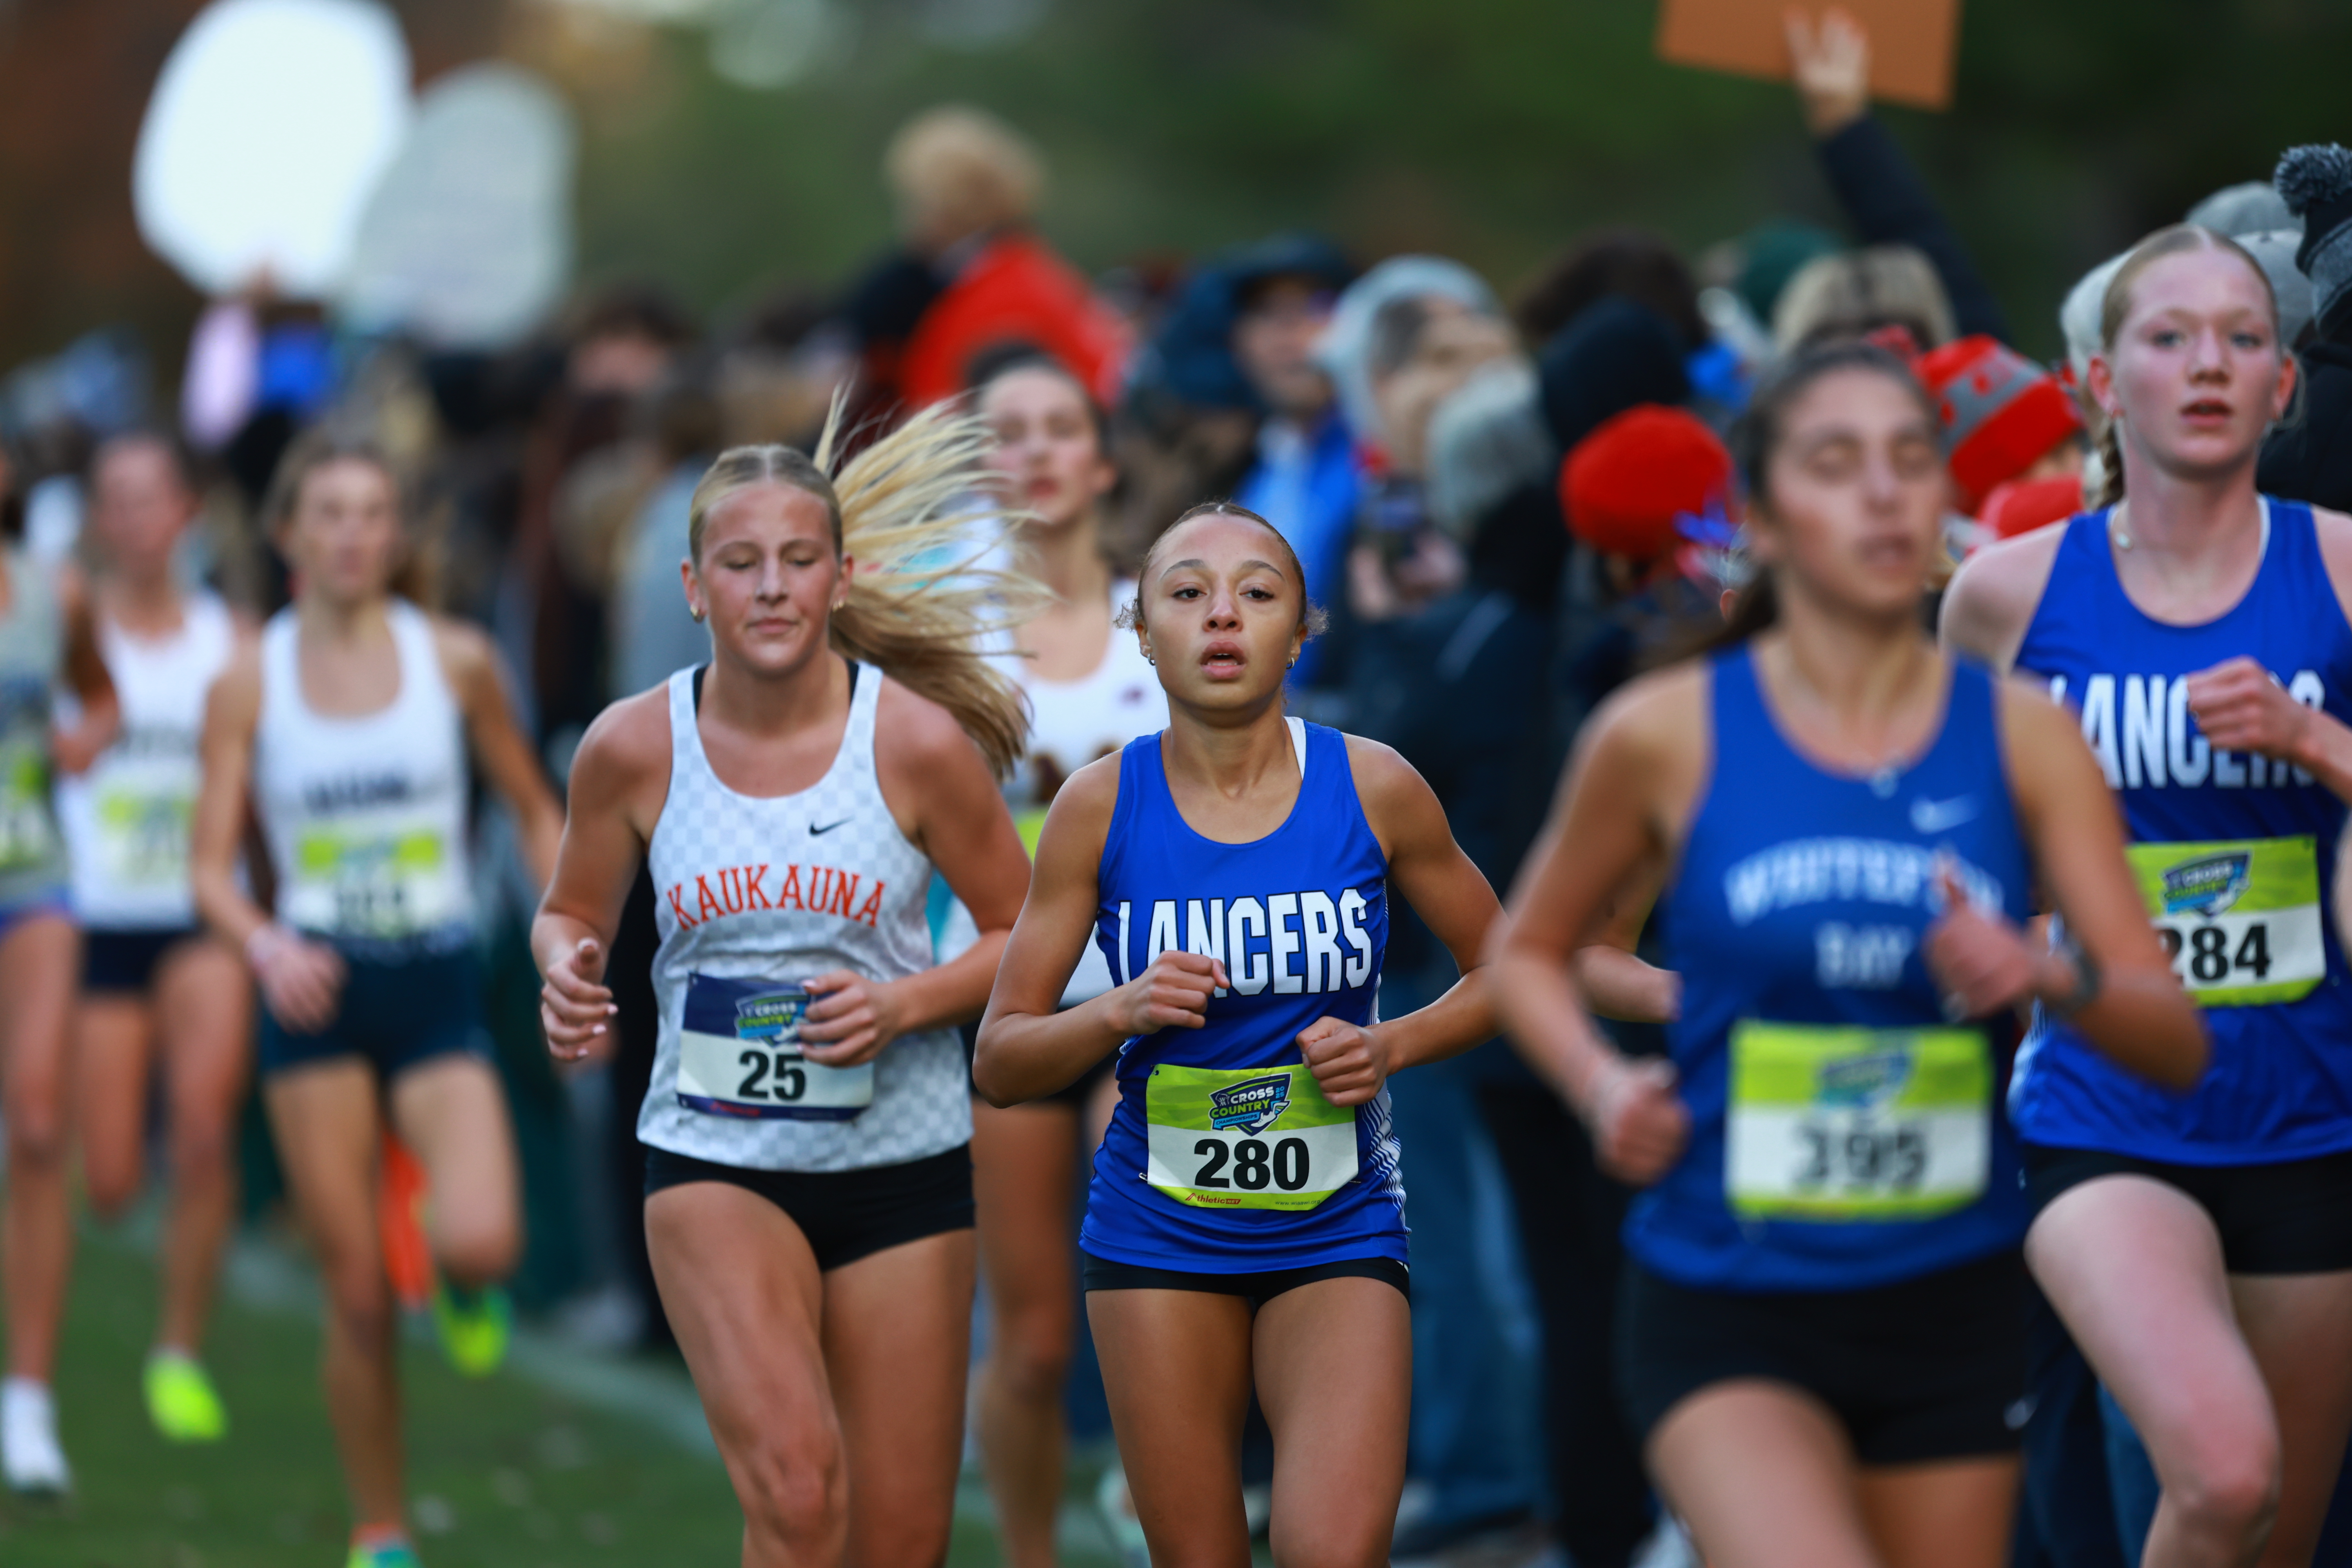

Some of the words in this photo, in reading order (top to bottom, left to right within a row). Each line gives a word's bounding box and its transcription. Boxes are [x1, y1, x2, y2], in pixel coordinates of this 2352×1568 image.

[2050, 670, 2325, 790] ANCS
[668, 864, 885, 931] KAUKAUNA
[1118, 888, 1372, 998] LANCERS
[1817, 922, 1911, 987] BAY
[737, 1051, 806, 1101] 25
[1230, 1086, 1274, 1104] CROSS
[1211, 1099, 1270, 1118] COUNTRY
[1216, 1114, 1258, 1125] CHAMPIONSHIPS
[1194, 1138, 1310, 1191] 280
